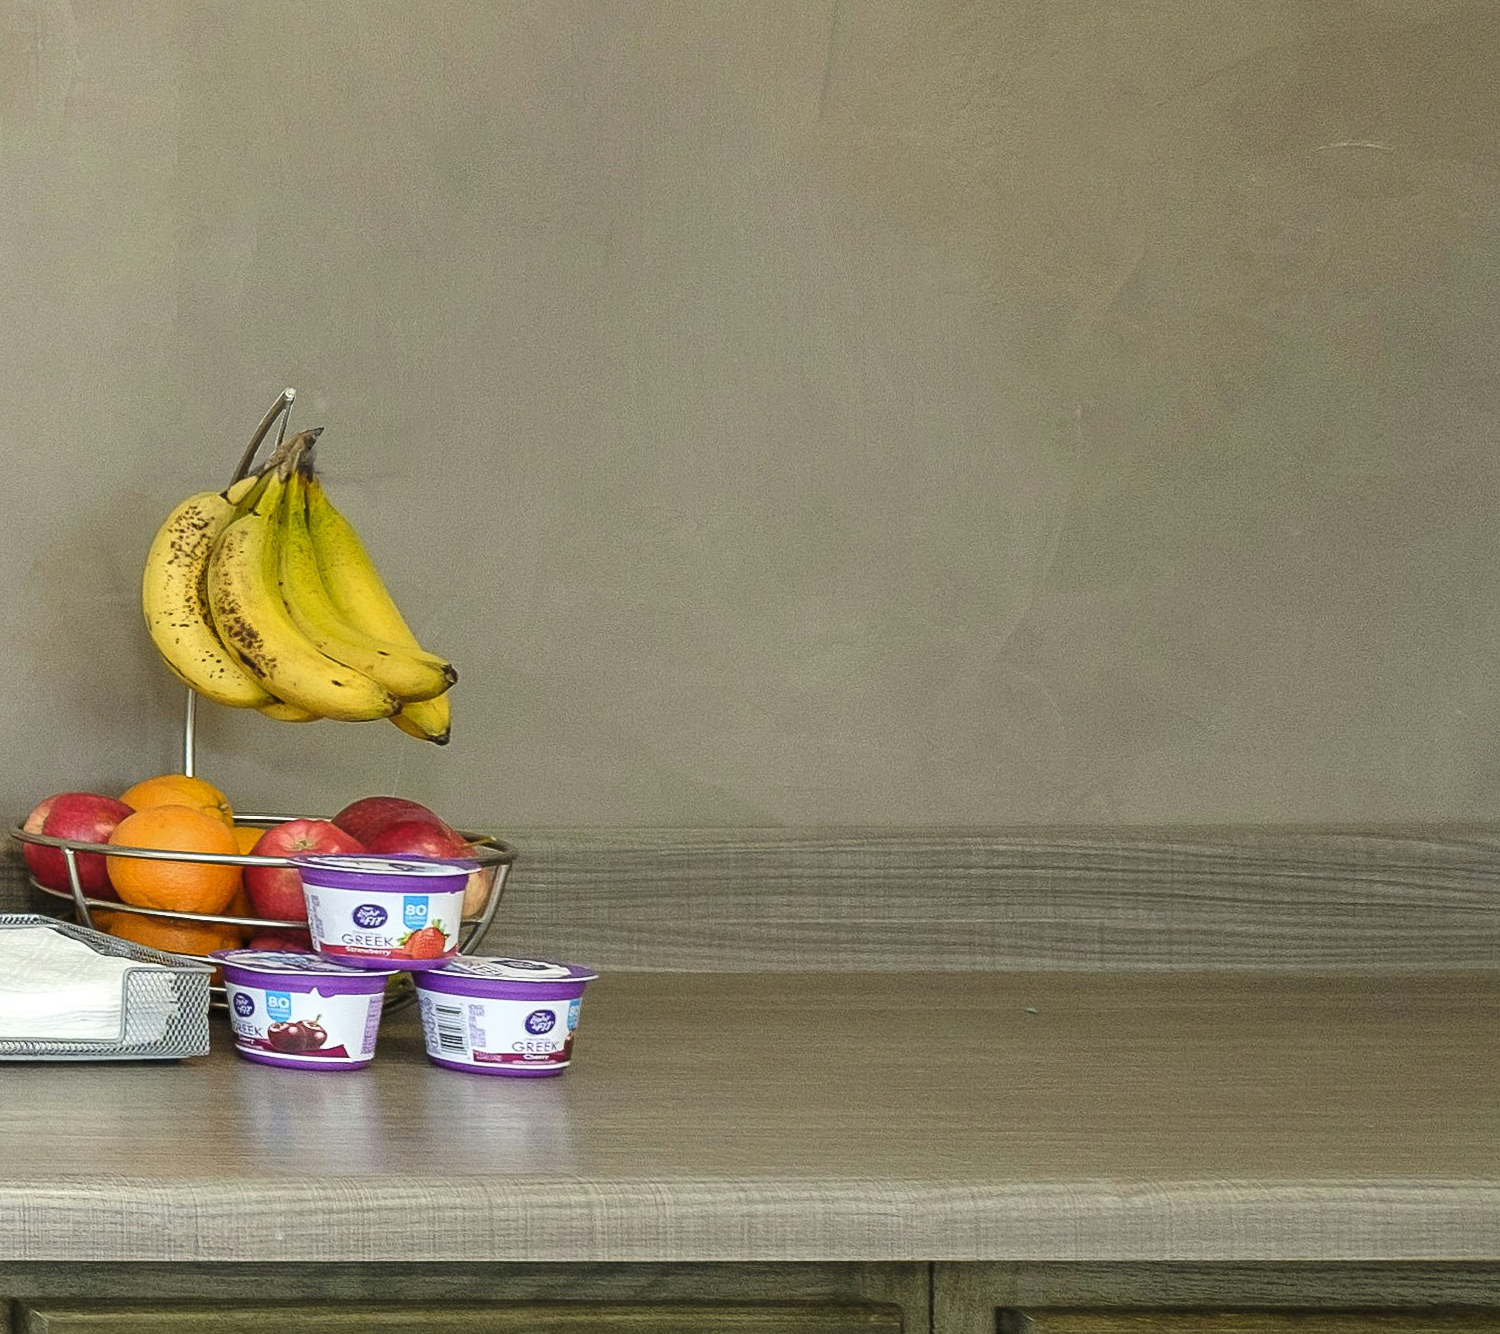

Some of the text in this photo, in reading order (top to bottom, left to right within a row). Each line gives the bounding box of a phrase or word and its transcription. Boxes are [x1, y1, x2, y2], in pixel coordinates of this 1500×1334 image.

[405, 904, 427, 916] 80
[341, 933, 395, 947] GREEK
[345, 945, 392, 957] Strawberry
[268, 996, 290, 1009] 80
[511, 1041, 560, 1053] GREEK
[523, 1053, 550, 1061] Cherry
